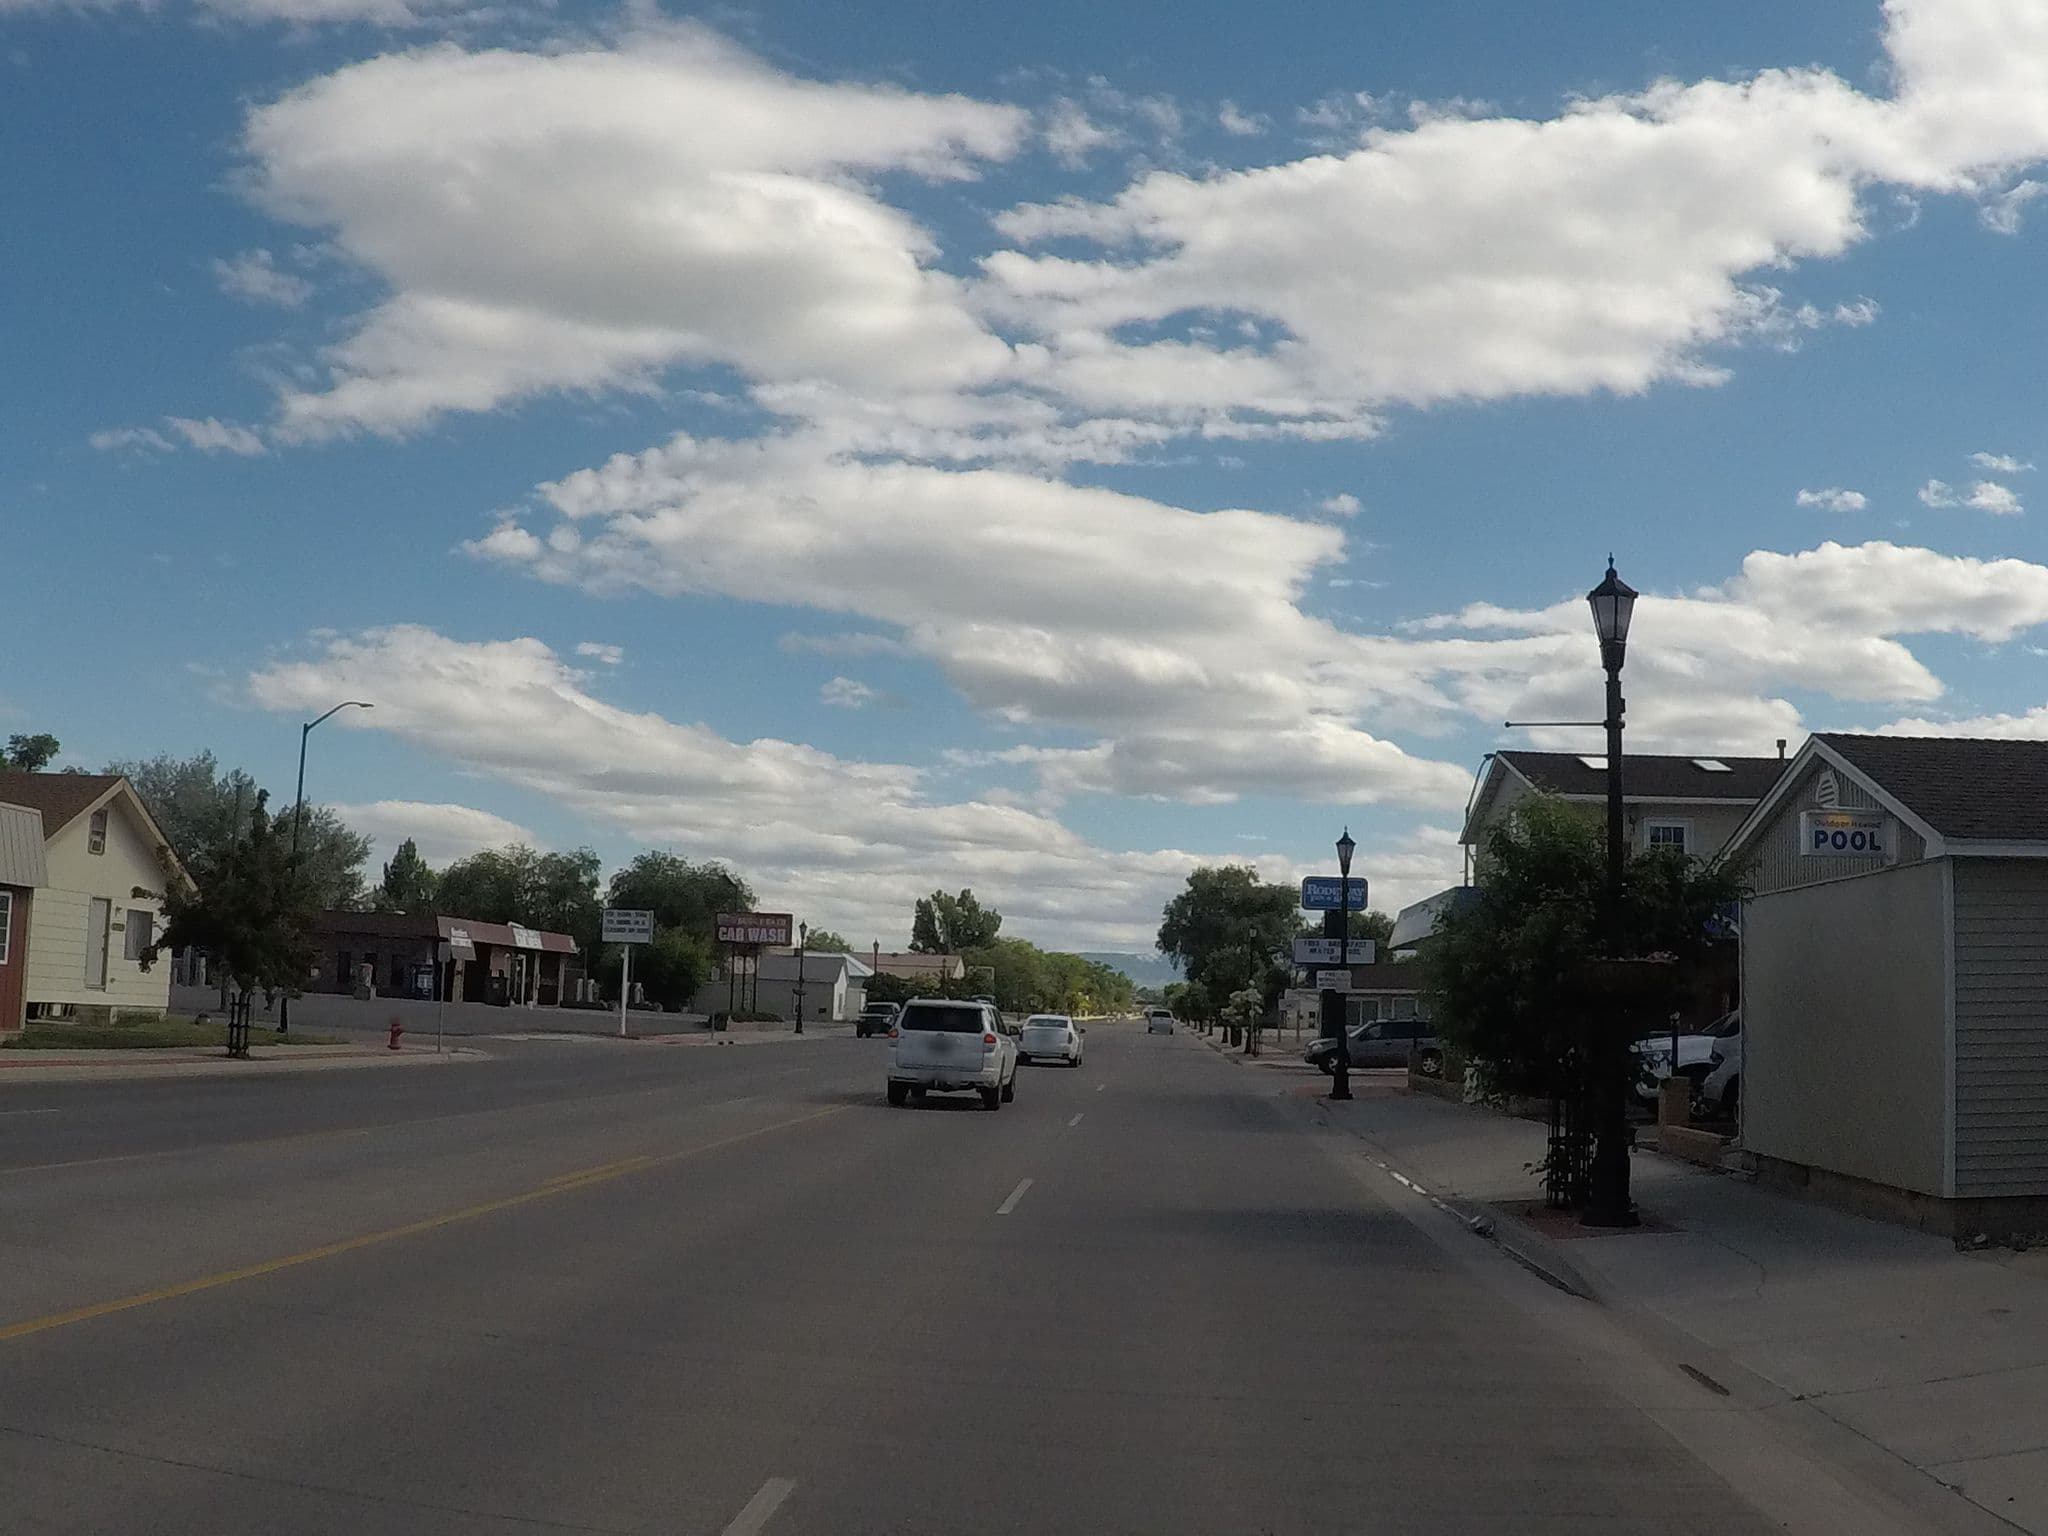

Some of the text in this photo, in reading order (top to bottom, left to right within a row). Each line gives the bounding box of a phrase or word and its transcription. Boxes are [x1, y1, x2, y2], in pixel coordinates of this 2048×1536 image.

[1814, 830, 1882, 851] POOL
[718, 926, 786, 944] CAR WASH
